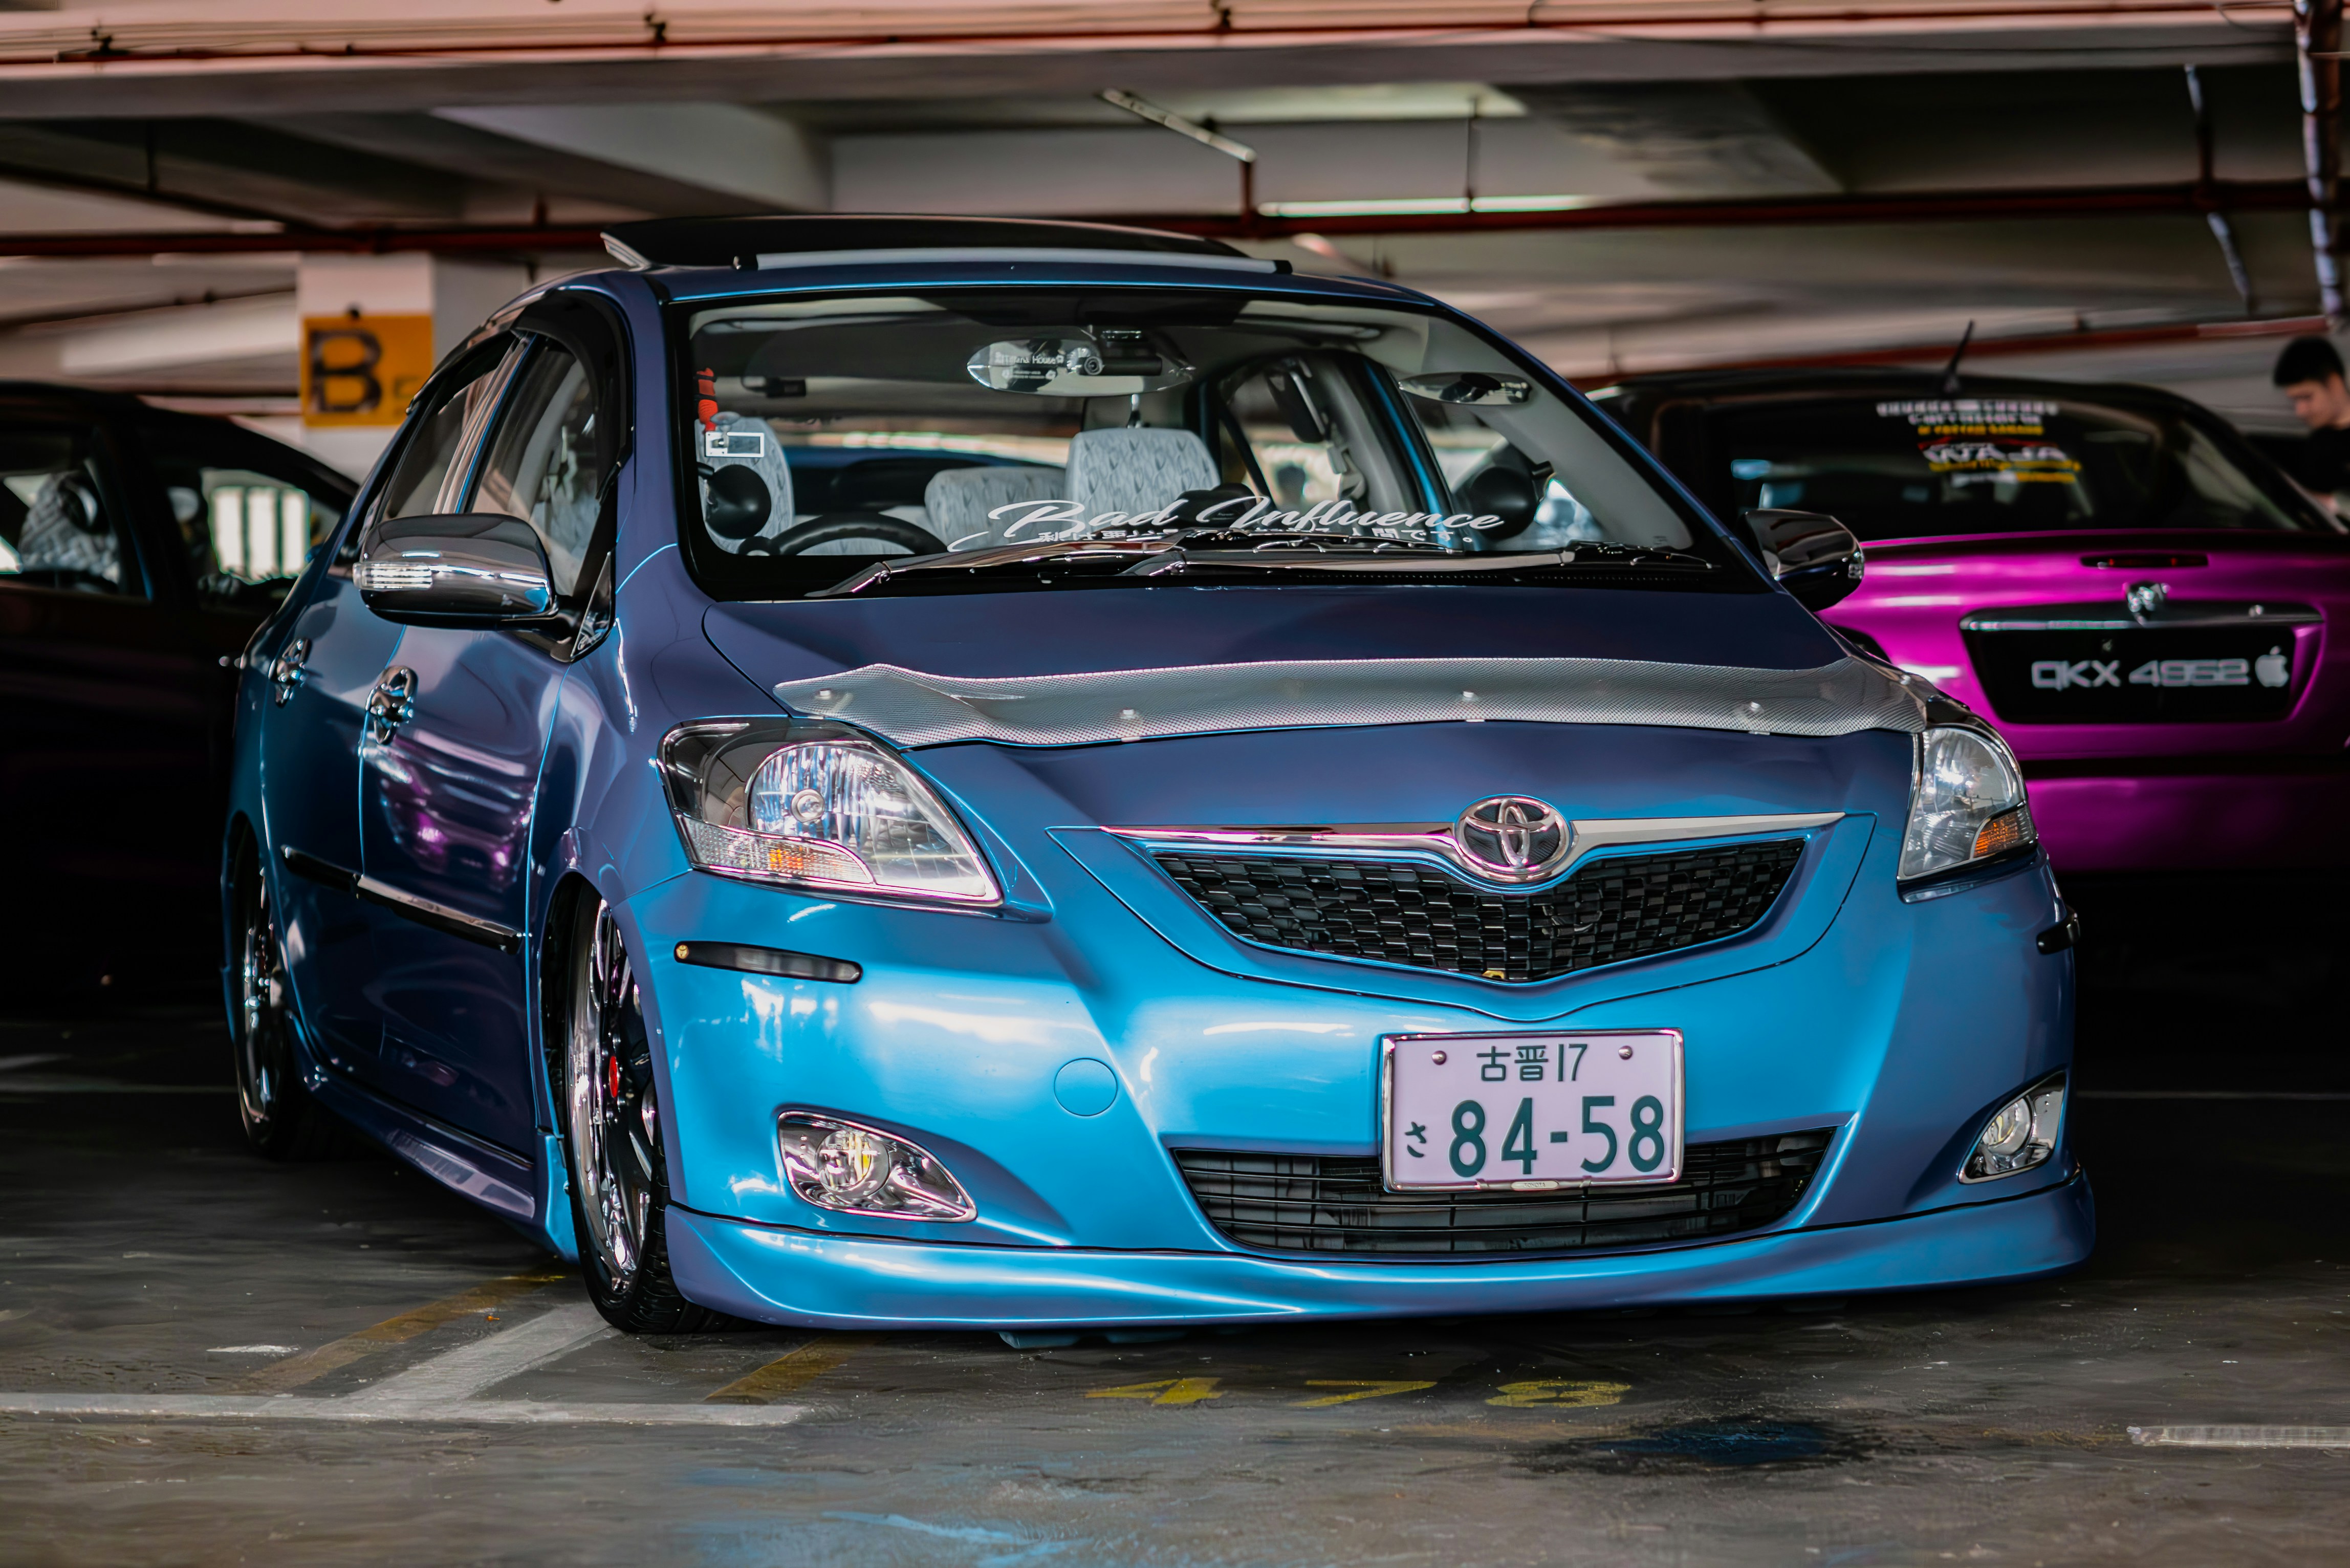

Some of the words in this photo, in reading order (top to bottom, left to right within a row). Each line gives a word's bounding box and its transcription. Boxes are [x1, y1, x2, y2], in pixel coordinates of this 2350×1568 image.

[310, 328, 382, 413] B
[947, 499, 1188, 552] Bad
[1195, 495, 1505, 532] Influence
[2032, 660, 2120, 690] QKX
[1405, 1122, 1426, 1158] さ
[1449, 1095, 1664, 1177] 84-58
